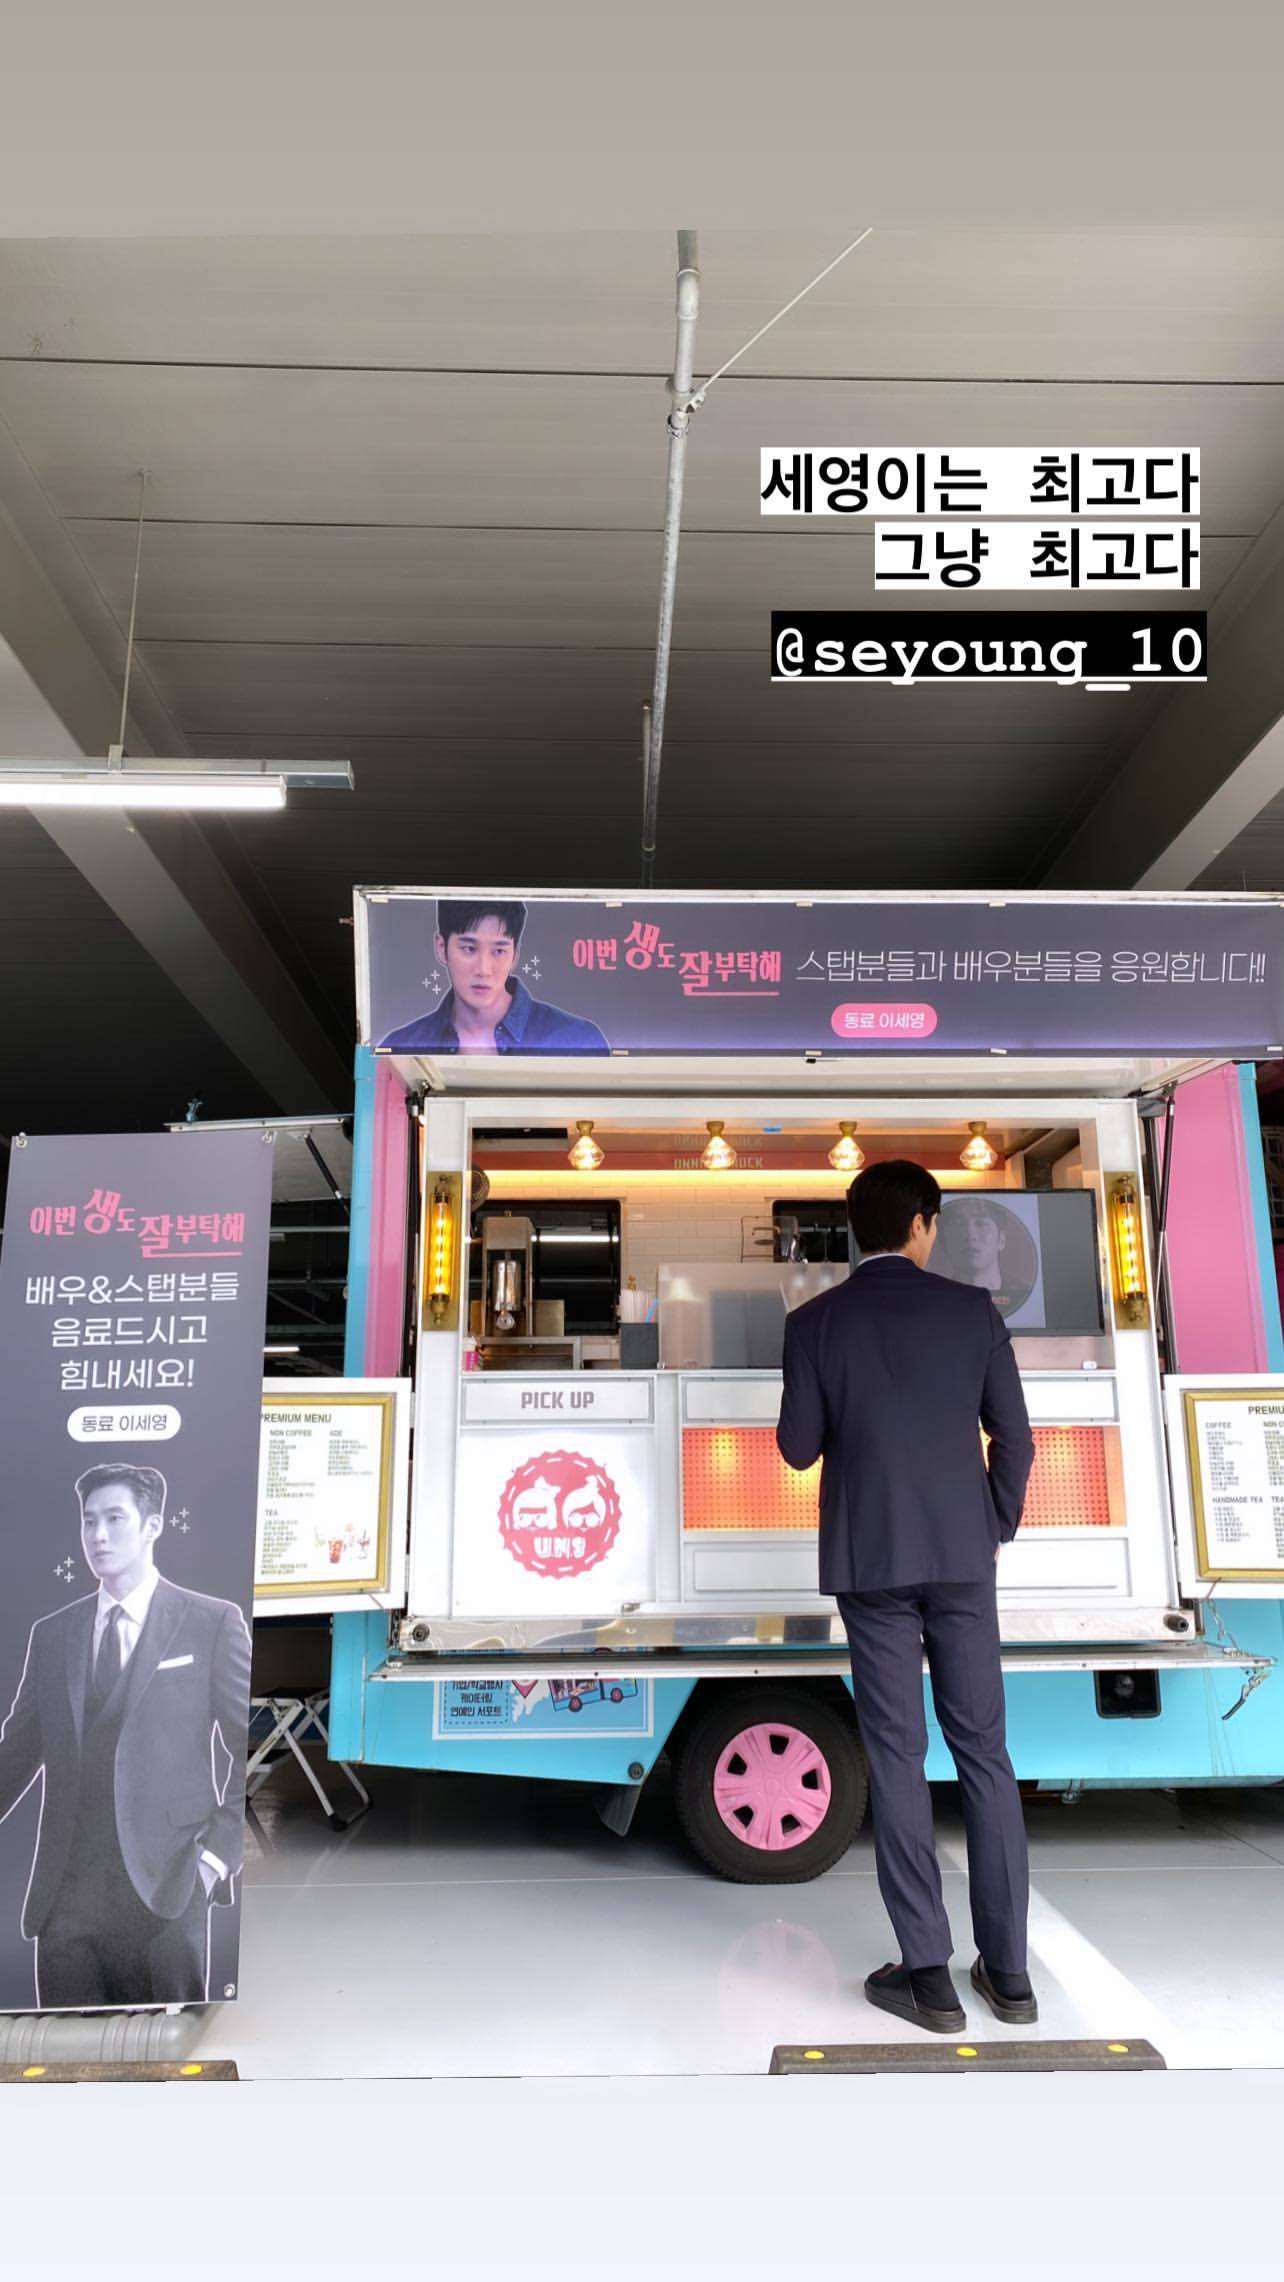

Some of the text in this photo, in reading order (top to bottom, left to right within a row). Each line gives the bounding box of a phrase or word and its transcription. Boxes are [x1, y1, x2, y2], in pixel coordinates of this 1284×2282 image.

[573, 938, 617, 971] 이번
[796, 950, 1266, 984] 스탭분들과 배우분들을 응원합니다!!
[844, 1011, 925, 1029] 동료 이세영
[29, 1205, 76, 1236] 이번
[25, 1272, 240, 1305] 배우&스탭분들
[51, 1315, 208, 1347] 음료드시고
[60, 1358, 195, 1391] 힘내세요!
[521, 1391, 595, 1409] PICK UP
[81, 1414, 167, 1433] 동료 이세영
[304, 1413, 331, 1424] MENU
